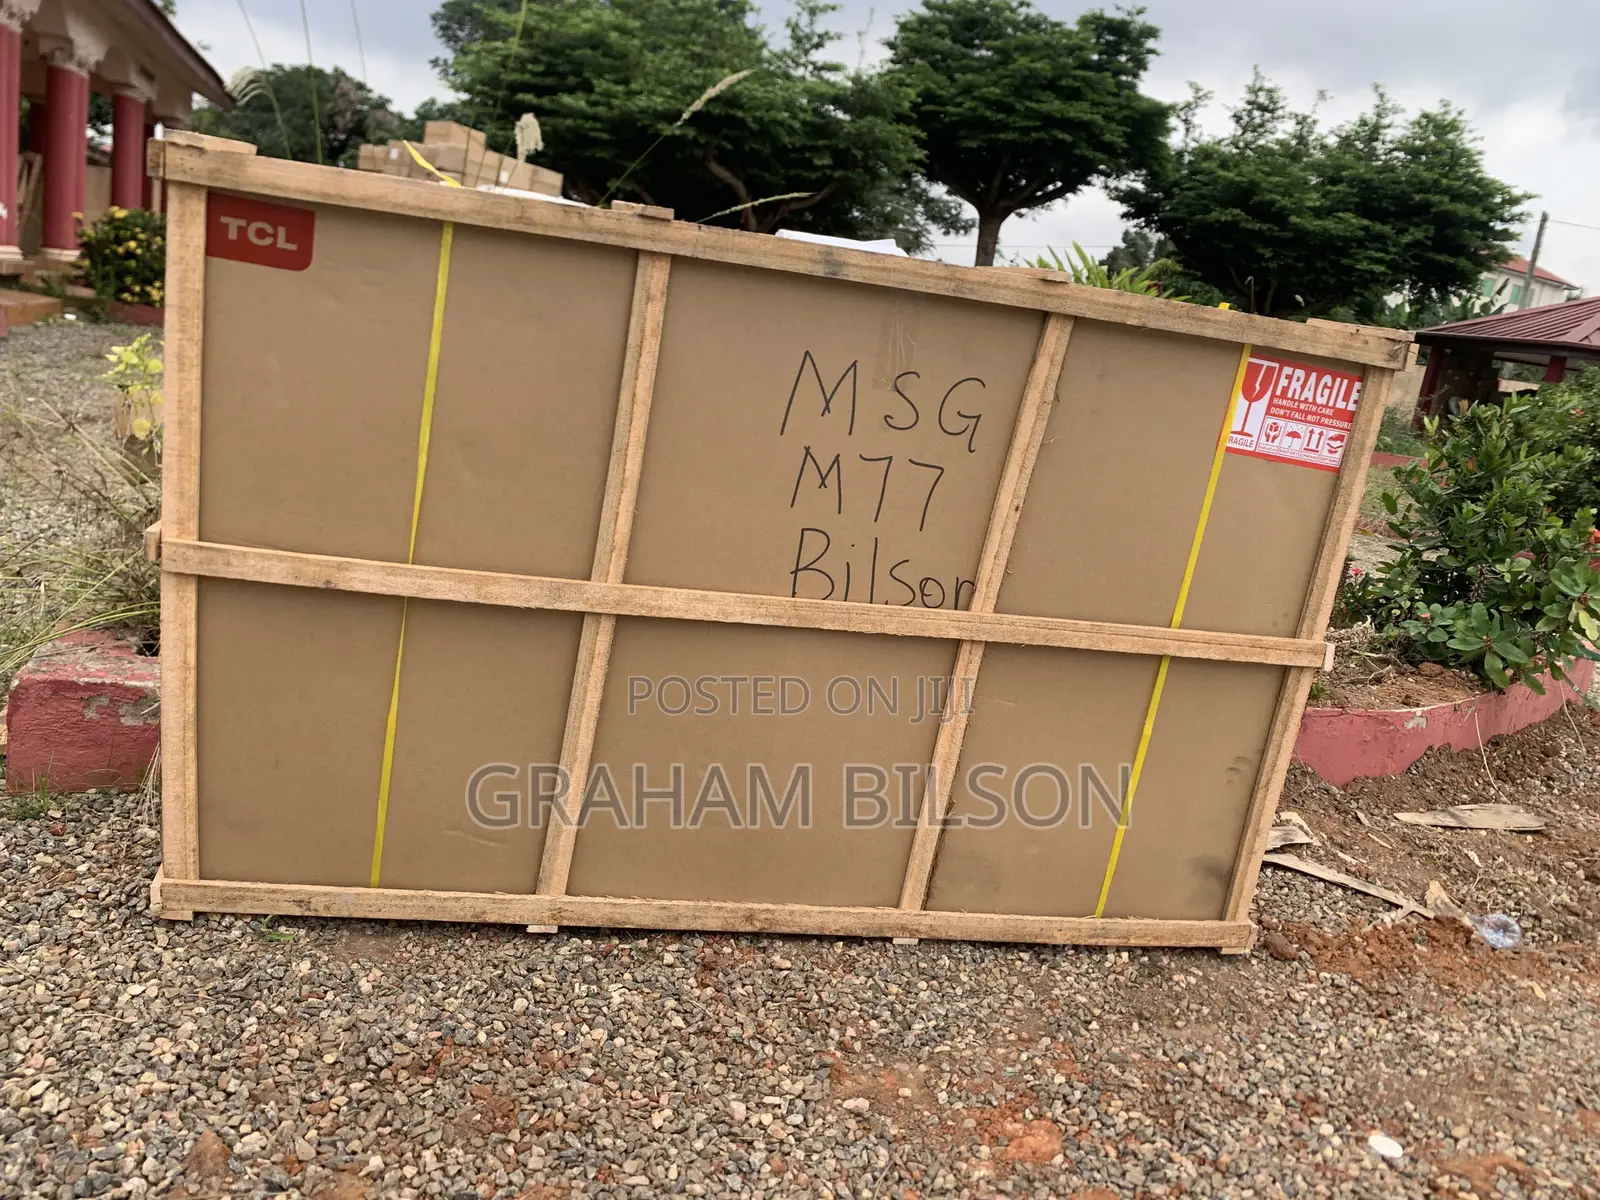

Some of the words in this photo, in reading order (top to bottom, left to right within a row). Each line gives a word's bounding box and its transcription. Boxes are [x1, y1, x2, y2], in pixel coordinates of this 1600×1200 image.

[220, 215, 298, 251] TCL
[780, 350, 985, 453] MSG
[1272, 397, 1299, 409] HANDLE
[1299, 402, 1317, 412] WITH
[1317, 406, 1334, 416] CARE
[1275, 366, 1362, 411] FRAGILE
[1270, 406, 1291, 417] DON'T
[1290, 410, 1306, 421] FALL
[1306, 414, 1321, 424] NOT
[1320, 417, 1352, 430] PRESSURE
[1228, 435, 1255, 448] RAGILE
[789, 445, 945, 532] M77
